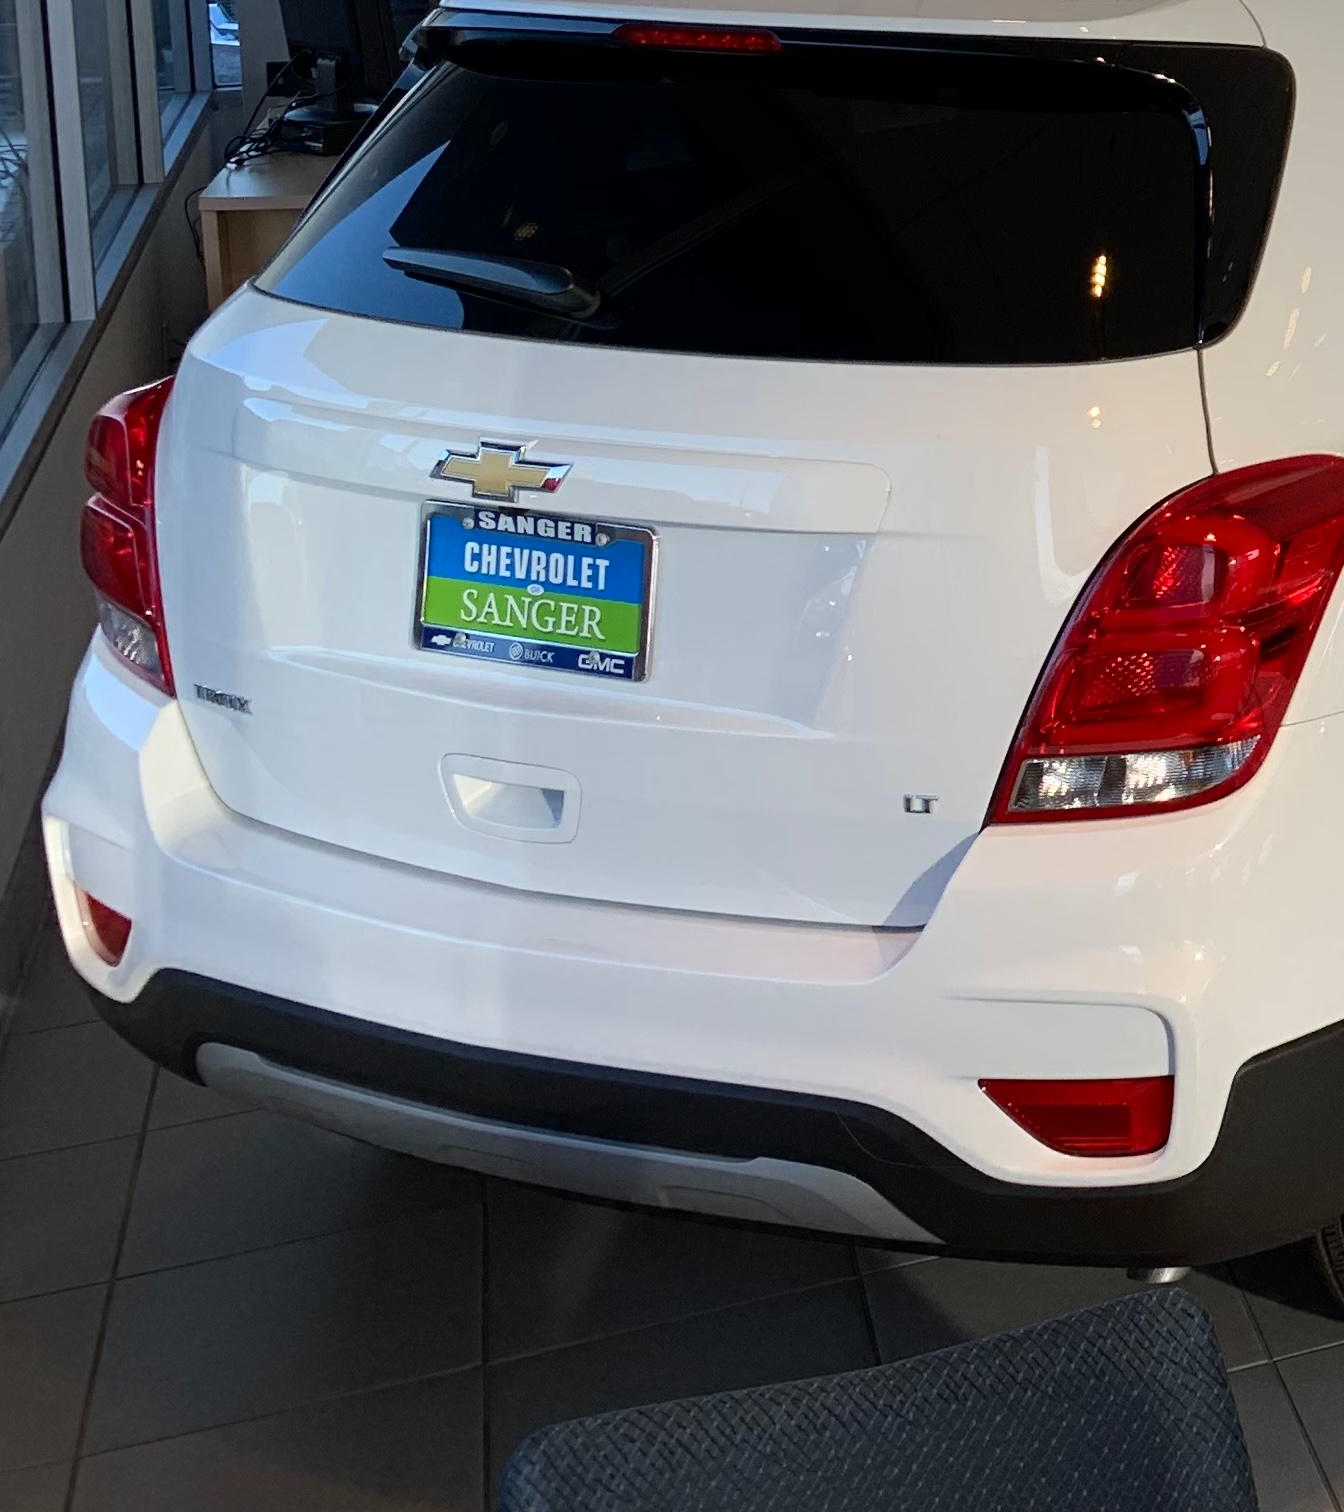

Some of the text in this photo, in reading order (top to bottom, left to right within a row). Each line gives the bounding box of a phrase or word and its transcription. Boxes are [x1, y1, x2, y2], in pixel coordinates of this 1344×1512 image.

[478, 510, 593, 543] SANGER
[464, 541, 610, 590] CHEVROLET
[460, 588, 606, 640] SANGER
[524, 649, 554, 664] BUICK
[578, 653, 625, 674] GMC
[903, 793, 938, 814] LT
